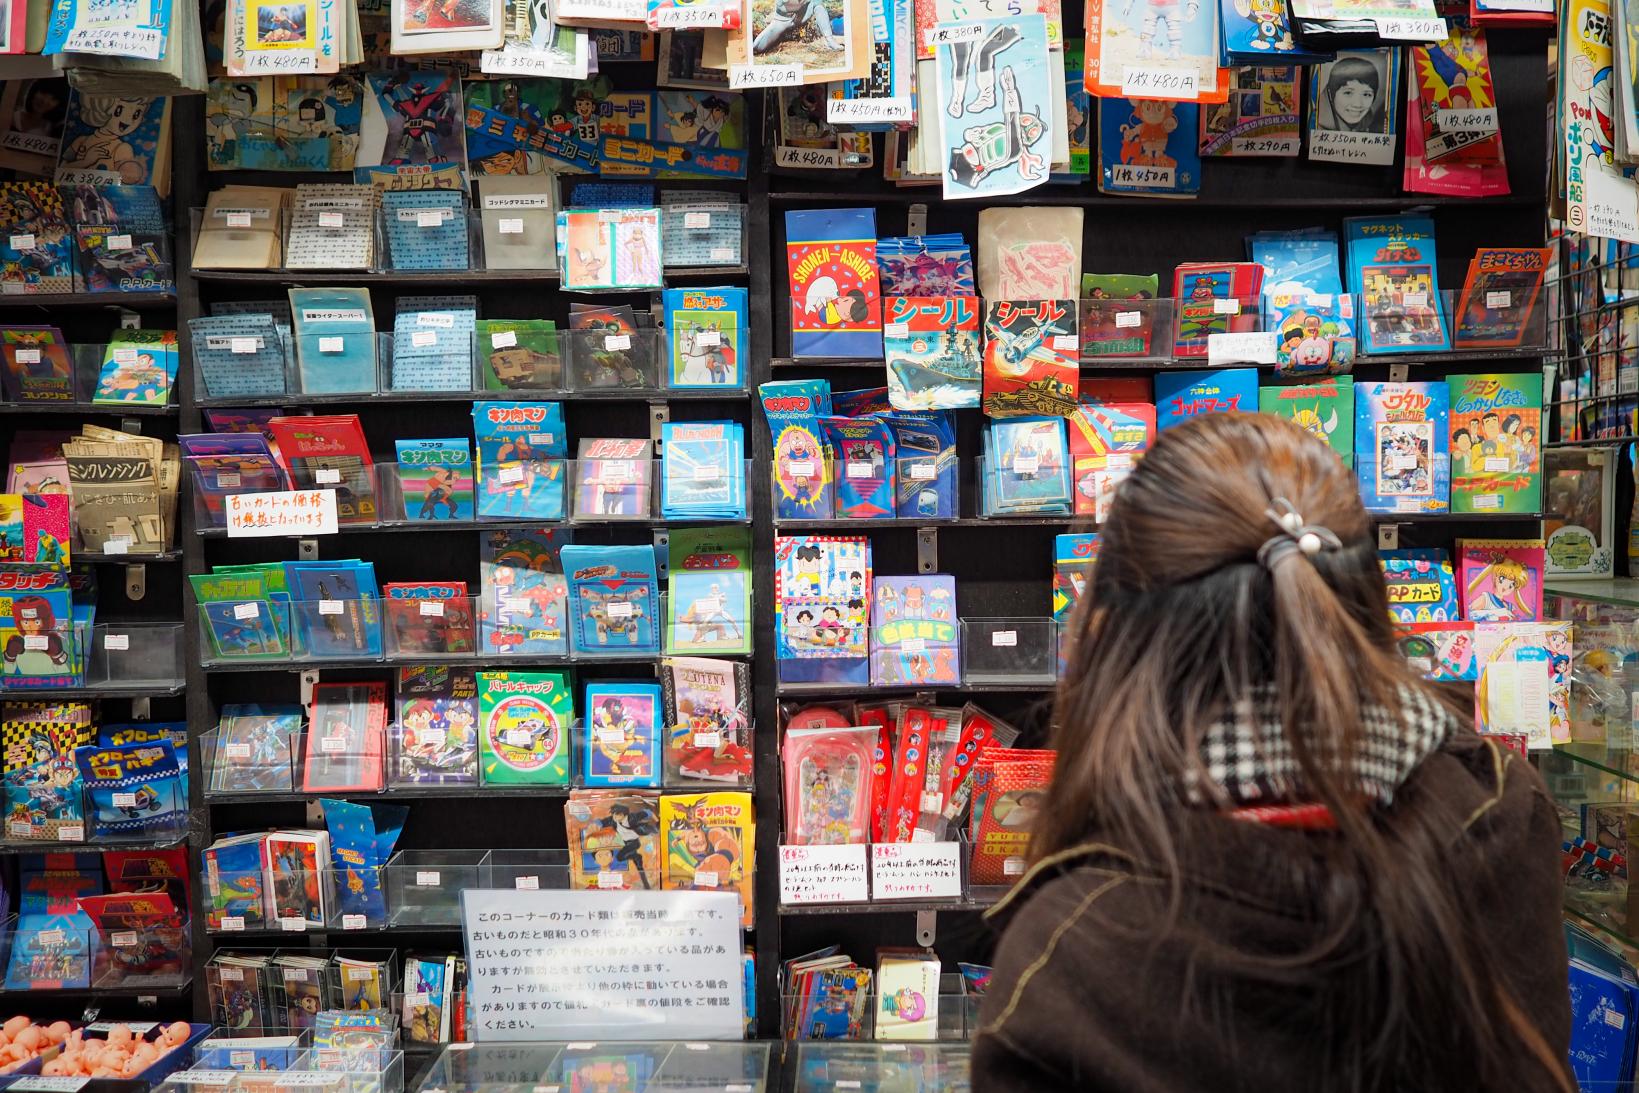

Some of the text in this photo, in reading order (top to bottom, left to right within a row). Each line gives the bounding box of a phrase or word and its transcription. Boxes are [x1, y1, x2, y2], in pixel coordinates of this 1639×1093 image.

[931, 25, 982, 41] 1枚380円
[249, 55, 311, 69] 1枚480円
[486, 56, 546, 71] 1枚350円
[733, 68, 798, 86] 1枚650円
[1126, 71, 1195, 90] 1枚480円
[1443, 114, 1493, 126] 1枚480円
[1235, 140, 1291, 152] 一枚290円
[781, 150, 834, 166] 1枚480円
[1114, 168, 1170, 184] 1枚450円
[488, 198, 546, 208] ゴッドシグマミニカード
[1361, 223, 1404, 235] マグネット
[1479, 251, 1544, 270] まことちゃん
[892, 297, 975, 326] シール
[998, 300, 1068, 327] シール
[1461, 378, 1502, 396] ツヨシ
[1170, 393, 1243, 417] ゴッドマーズ
[1381, 389, 1433, 411] ワタル
[1454, 386, 1528, 414] しっかりしなさい
[488, 407, 547, 423] キン肉マン
[399, 449, 469, 466] キン肉マン
[488, 680, 554, 693] バトルキャップ
[695, 806, 742, 818] キン肉マン
[484, 1018, 537, 1030] ください。
